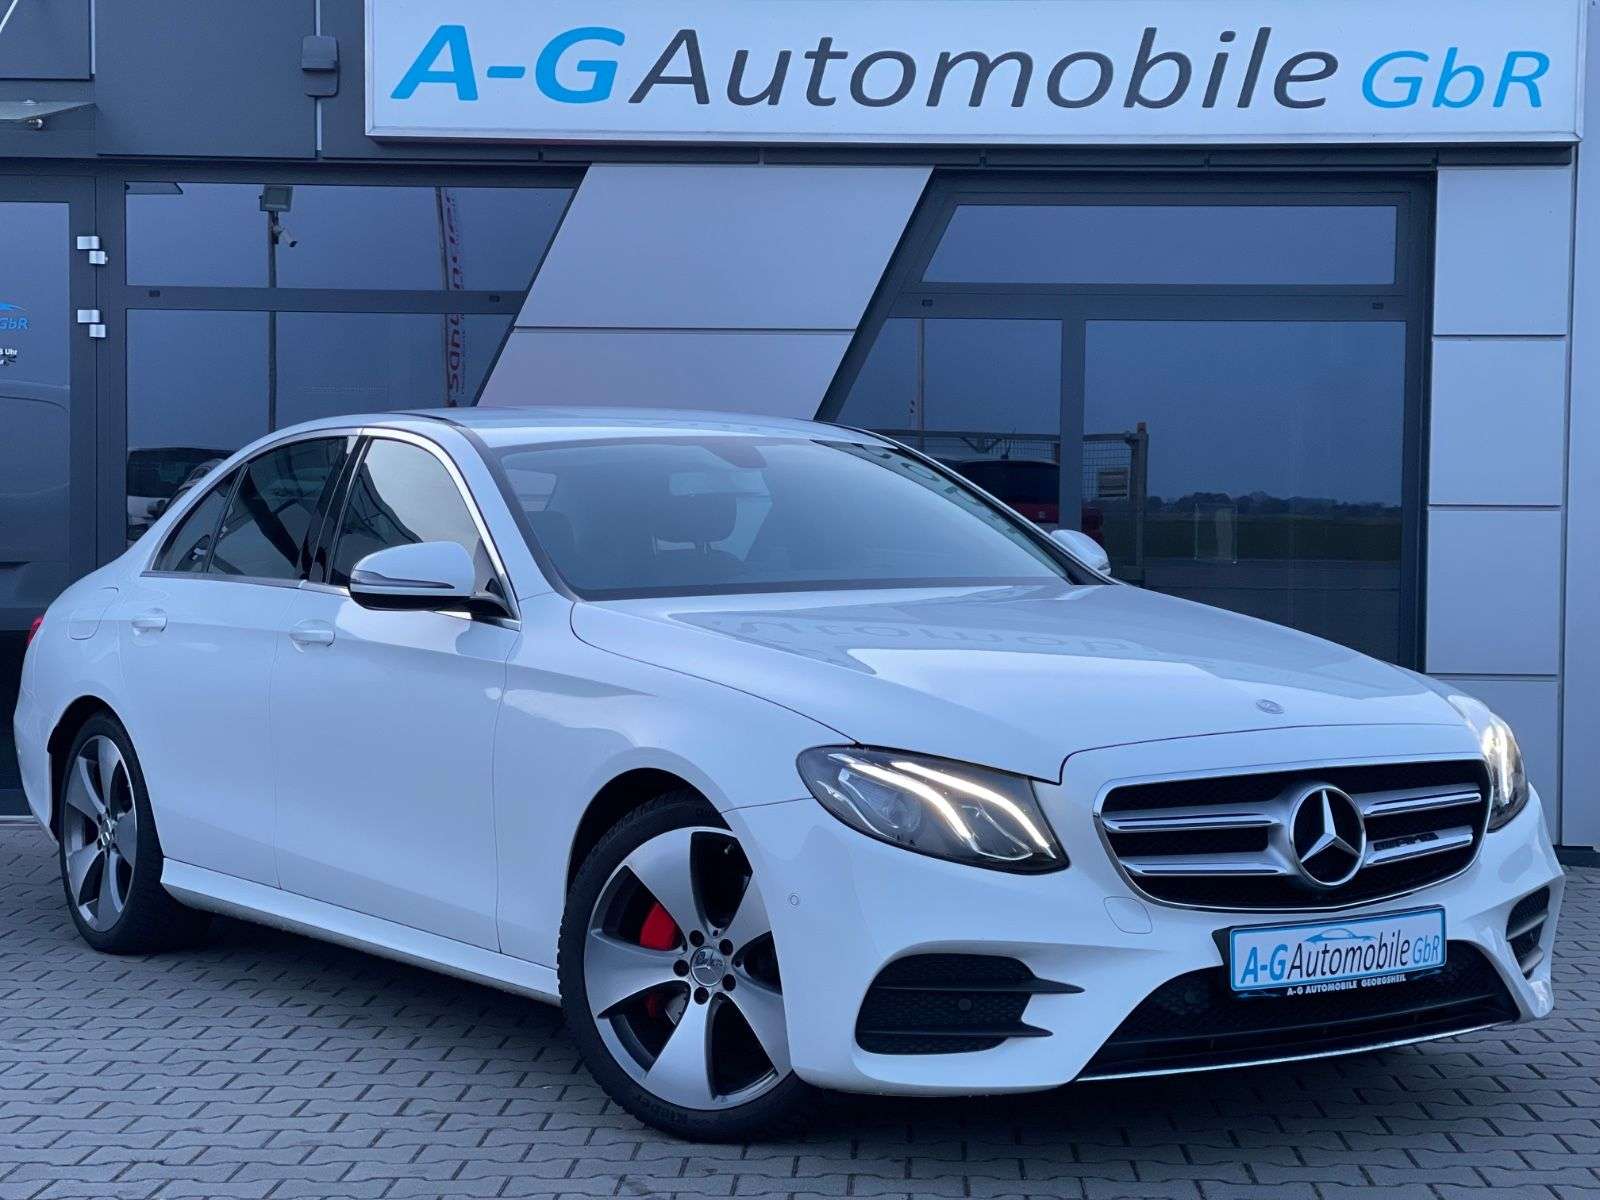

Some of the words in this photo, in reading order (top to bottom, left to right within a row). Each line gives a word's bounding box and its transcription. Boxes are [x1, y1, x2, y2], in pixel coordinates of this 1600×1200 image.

[1361, 47, 1551, 109] GbR
[1412, 934, 1440, 964] GbR
[1287, 986, 1304, 996] A-G
[1305, 980, 1358, 994] AUTOMOBILE
